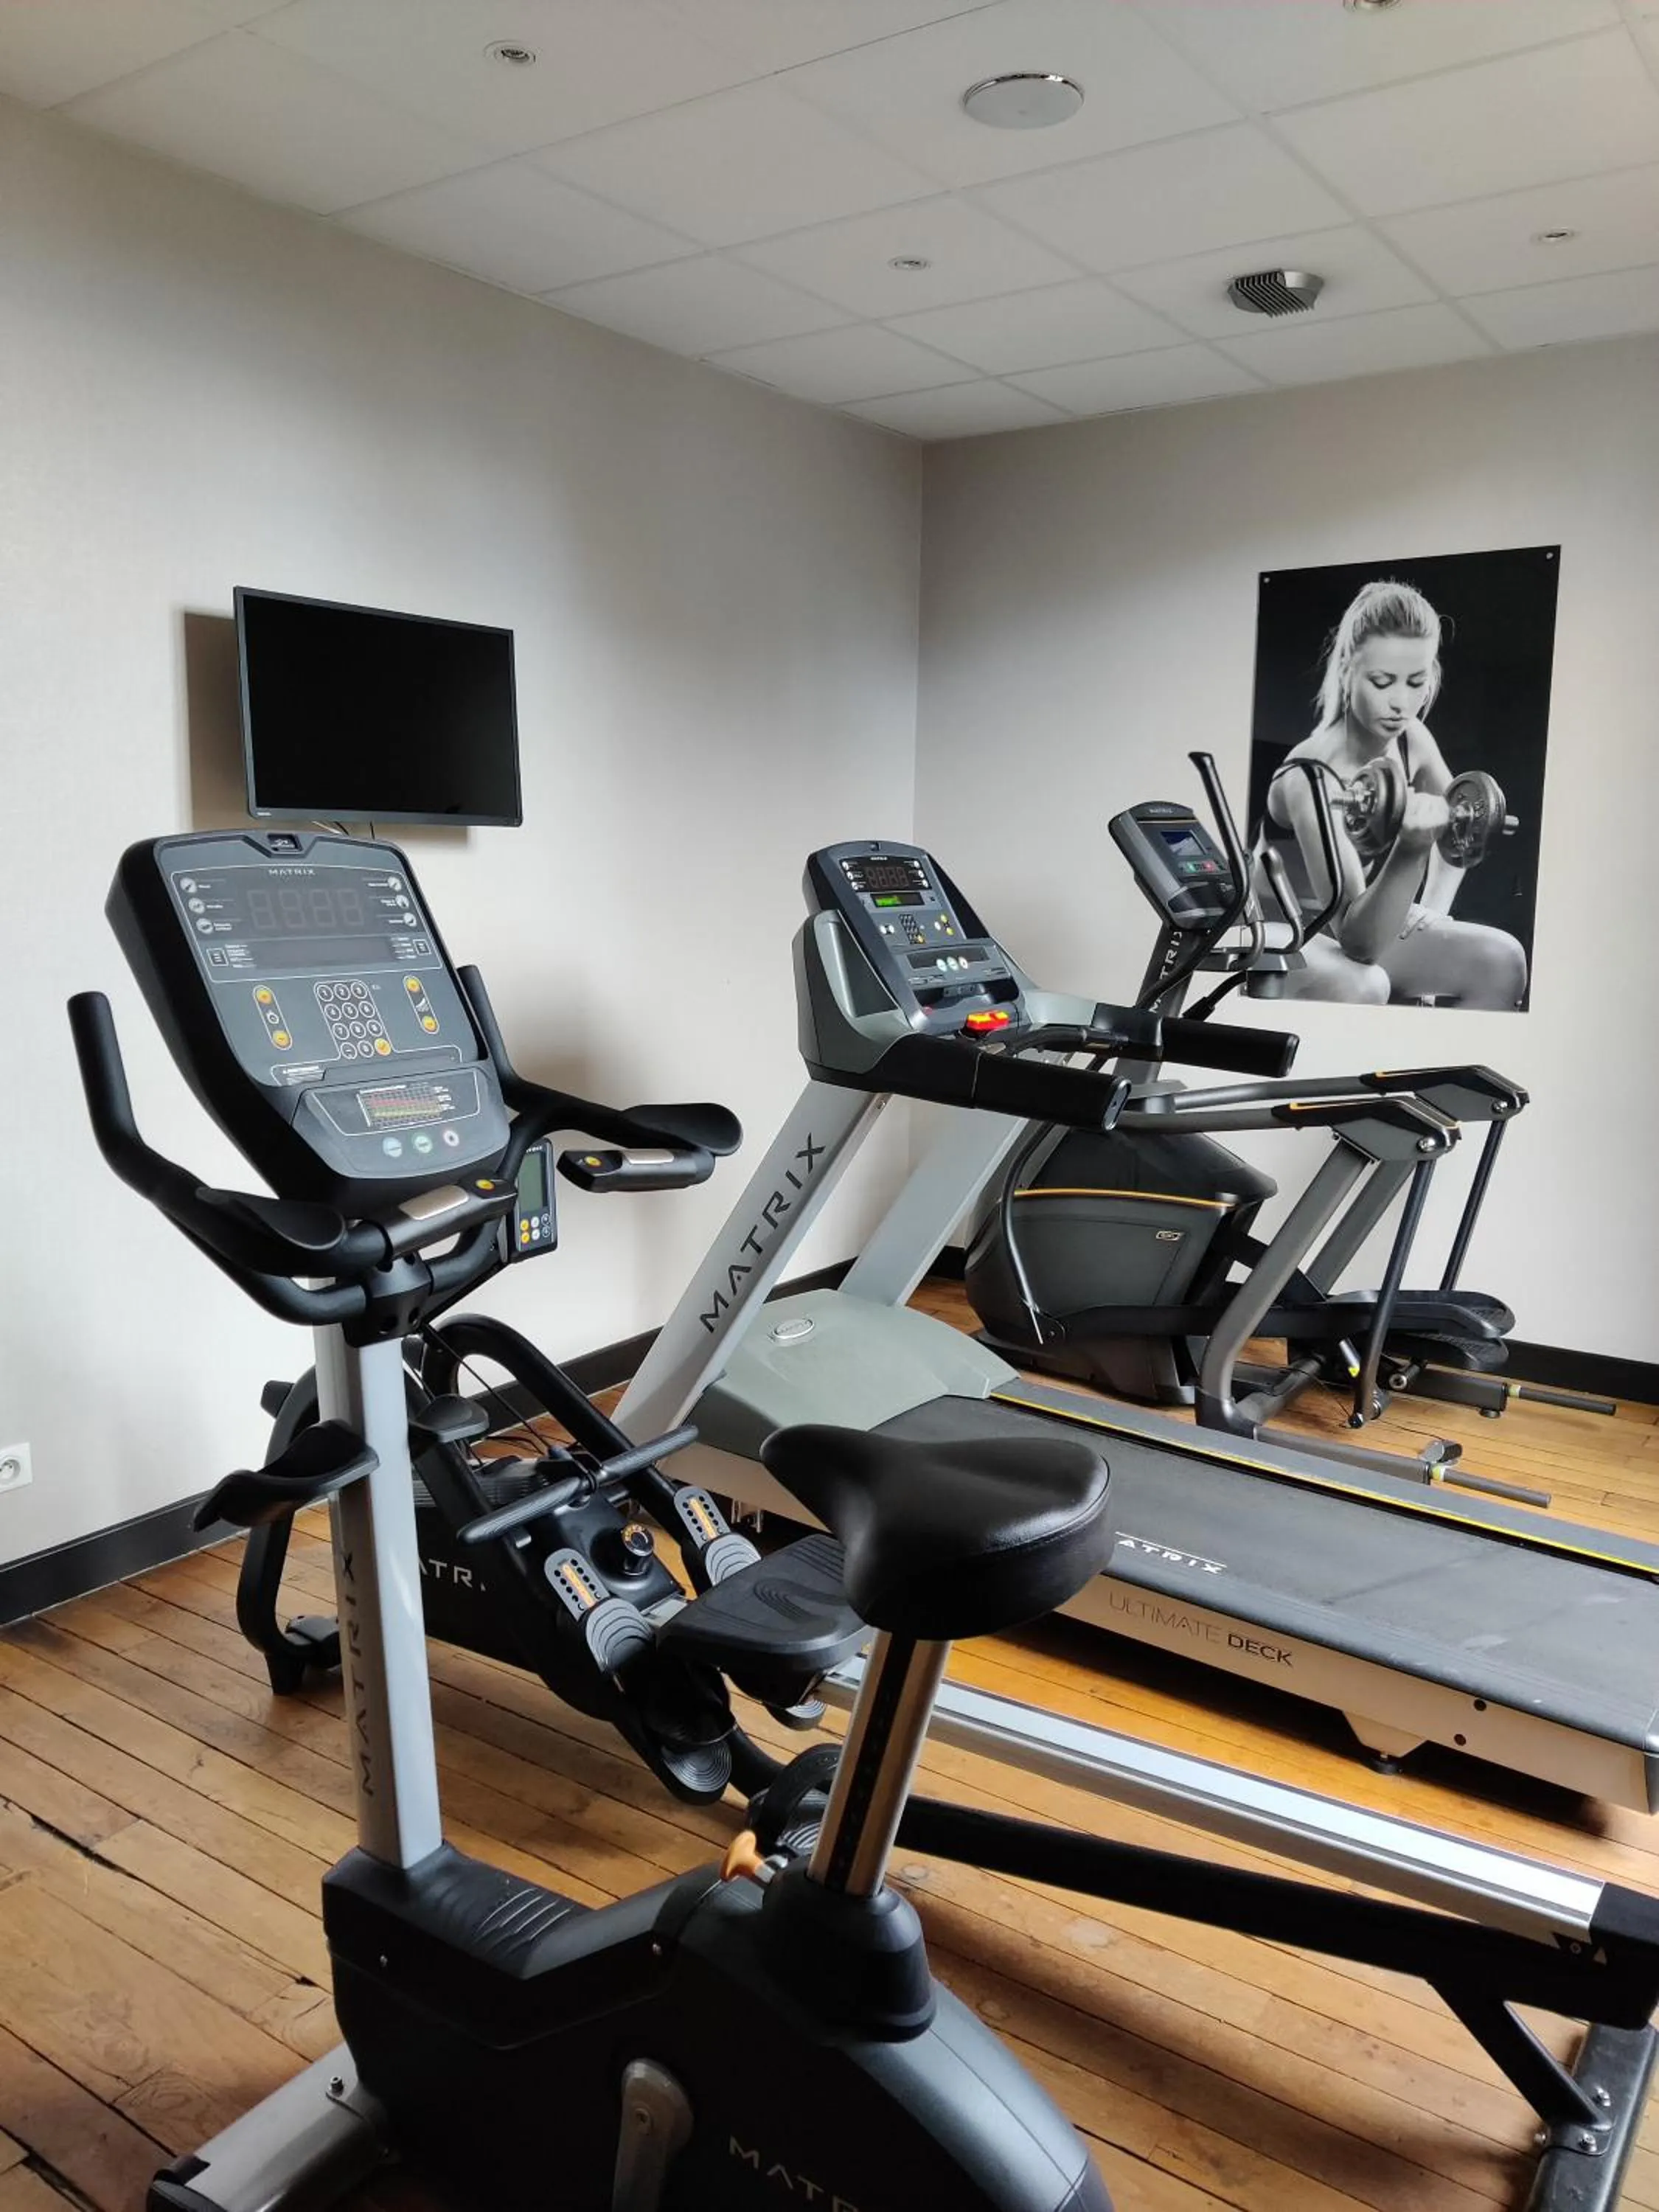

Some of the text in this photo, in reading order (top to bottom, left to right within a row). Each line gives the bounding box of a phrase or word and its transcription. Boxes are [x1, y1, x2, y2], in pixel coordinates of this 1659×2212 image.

[699, 1132, 826, 1333] MATRIX
[1118, 1539, 1224, 1575] ATRIX
[342, 1552, 374, 1796] MATRIX
[1109, 1591, 1294, 1668] ULTIMATE DECK
